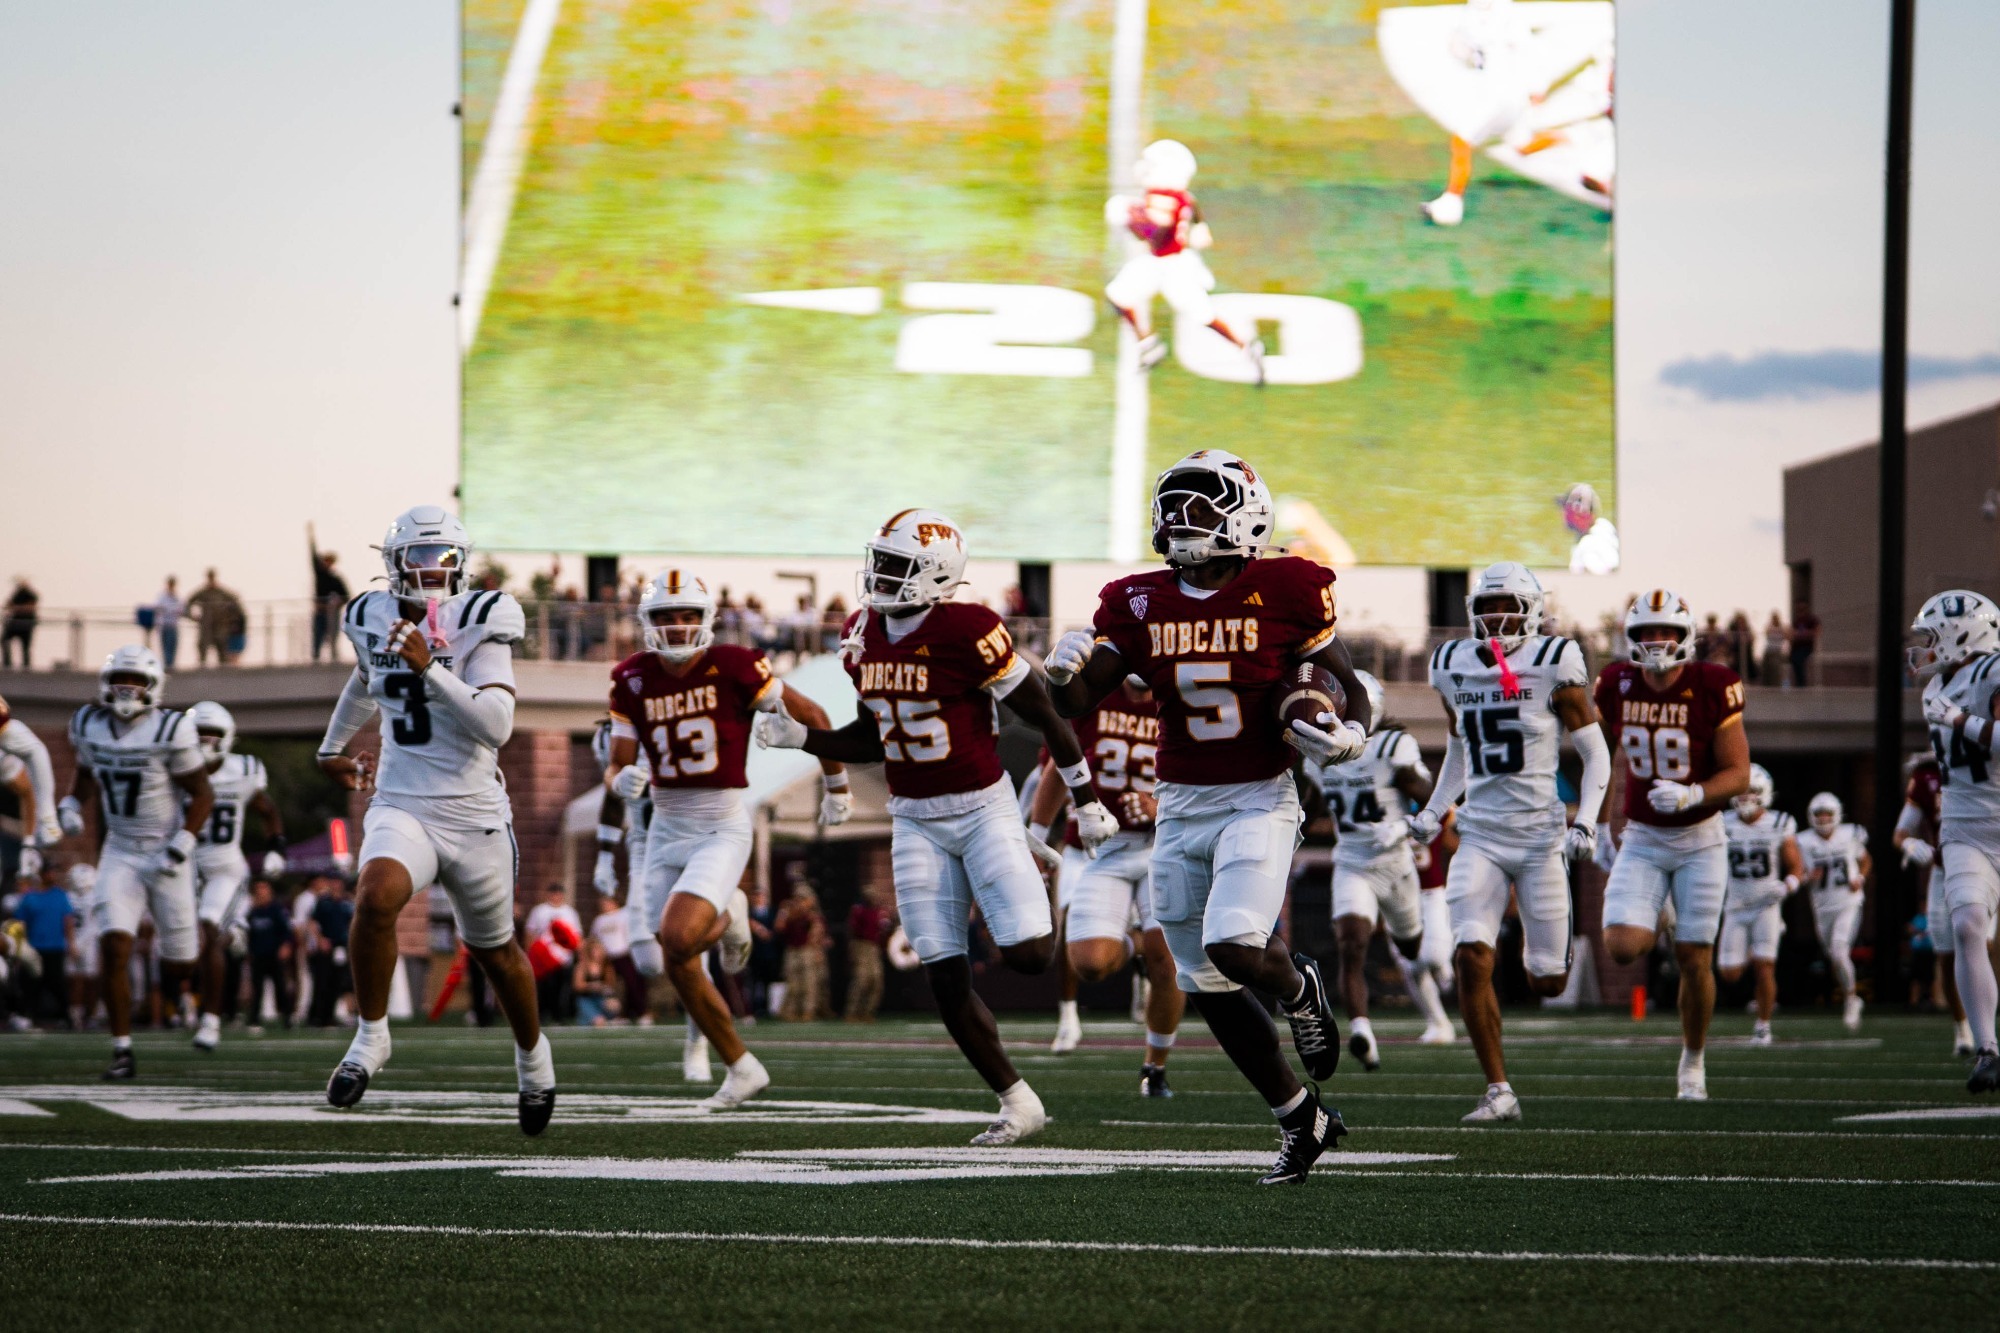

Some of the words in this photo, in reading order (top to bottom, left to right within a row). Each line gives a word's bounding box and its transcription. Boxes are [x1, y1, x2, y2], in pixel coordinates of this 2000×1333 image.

[1148, 617, 1259, 657] BOBCATS
[370, 653, 400, 668] TAH
[860, 662, 928, 692] BOBCATS
[384, 673, 433, 745] 3
[644, 685, 718, 721] BOBCATS
[1175, 661, 1244, 742] 5
[1455, 692, 1485, 705] UTAH
[1622, 700, 1688, 725] BOBCATS
[863, 697, 951, 762] 25
[1098, 709, 1160, 739] BOBCAT
[1463, 707, 1524, 774] 15
[652, 716, 719, 778] 13
[1621, 725, 1691, 780] 88
[100, 771, 141, 817] 17
[1313, 1105, 1329, 1144] NIKE
